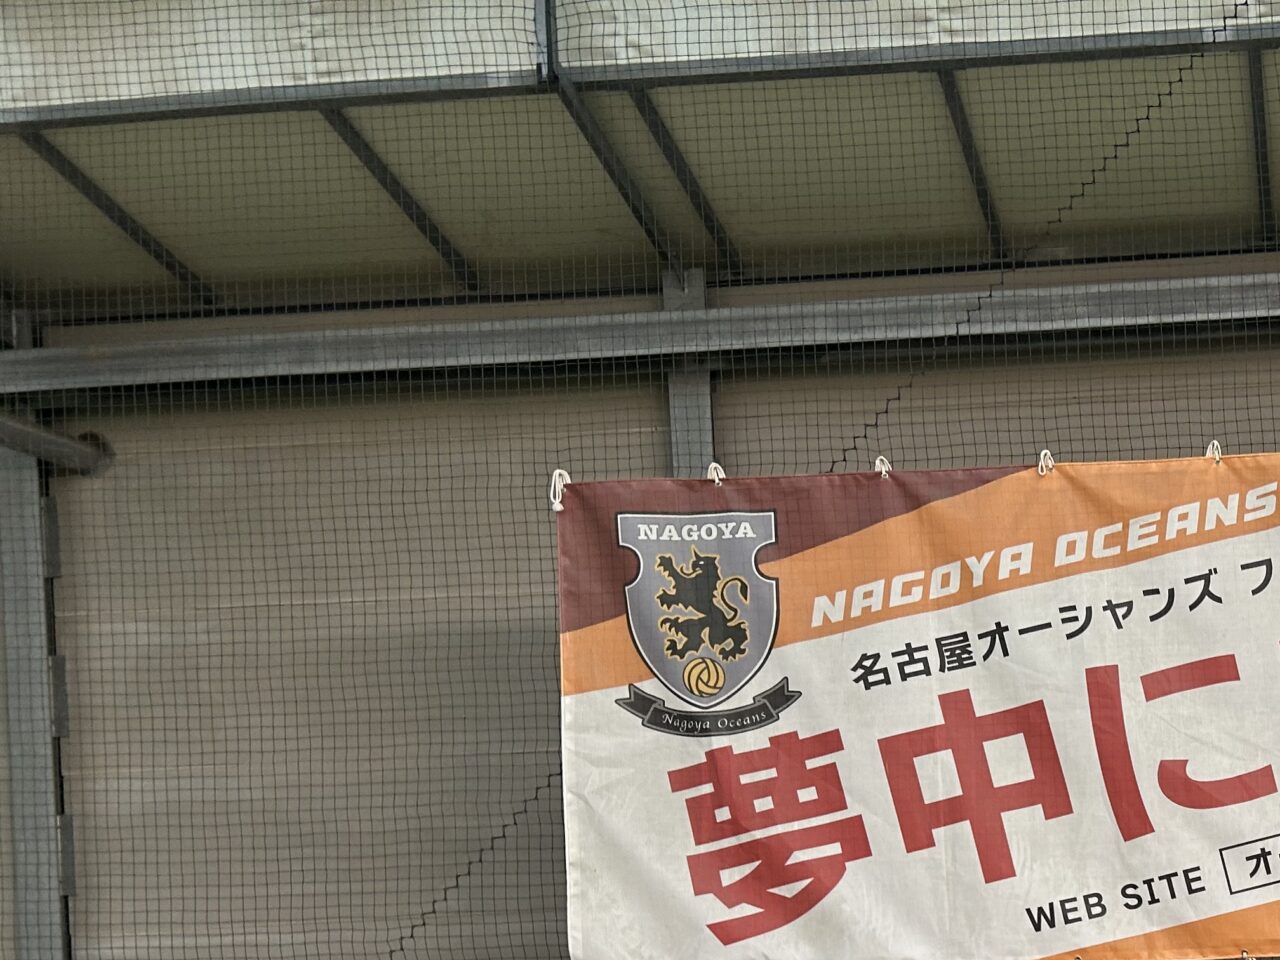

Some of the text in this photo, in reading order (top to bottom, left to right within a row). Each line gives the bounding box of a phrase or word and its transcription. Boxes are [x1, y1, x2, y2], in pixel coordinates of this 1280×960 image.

[636, 521, 757, 541] NAGOYA
[811, 481, 1279, 628] NAGOYA OCEANS
[851, 567, 1223, 691] 名古屋オーシャンズ
[661, 712, 767, 734] Nagoya Oceans
[1025, 866, 1206, 933] WEB SITE
